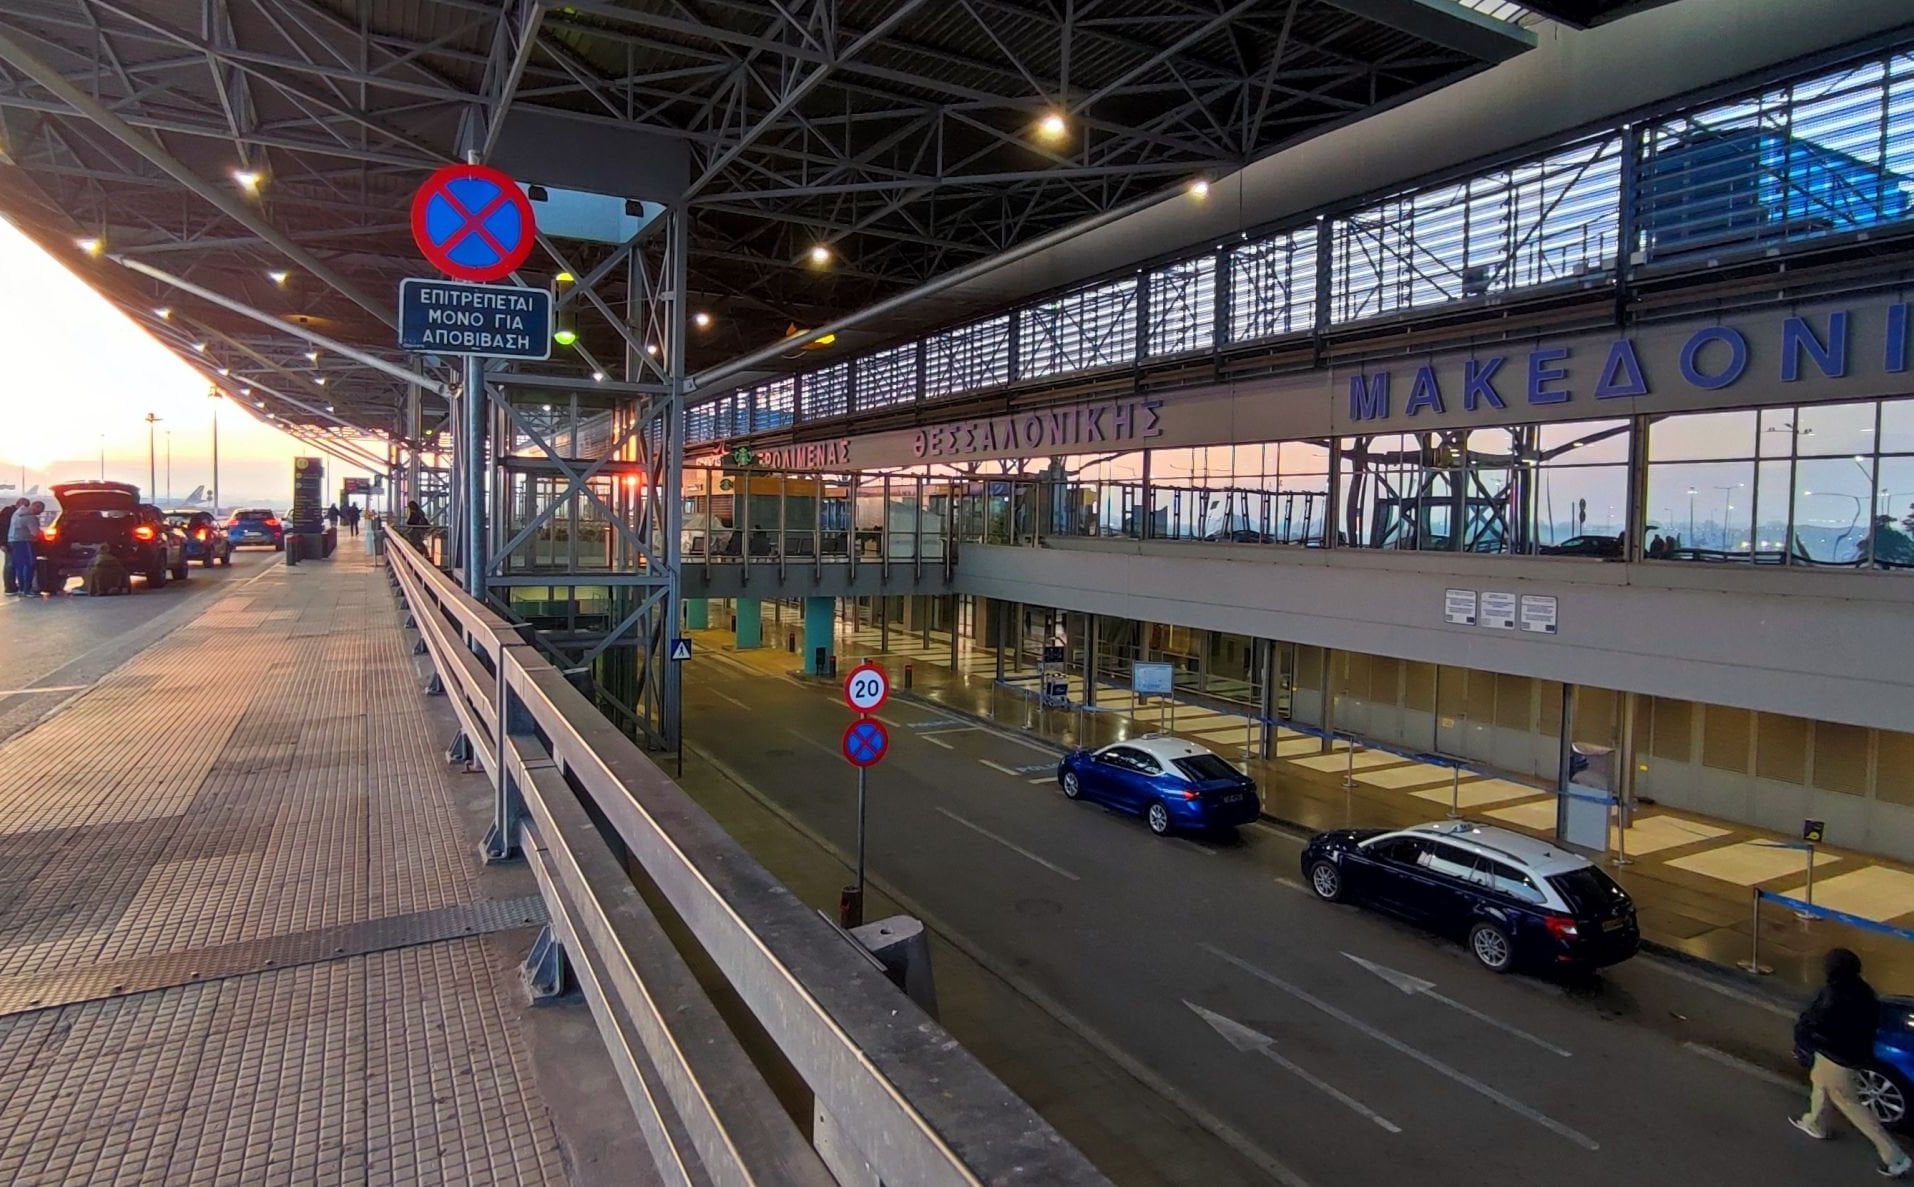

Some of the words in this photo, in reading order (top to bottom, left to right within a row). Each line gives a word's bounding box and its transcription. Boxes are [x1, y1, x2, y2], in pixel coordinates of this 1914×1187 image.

[420, 288, 533, 312] ΕΠΙΤΡΕΠΕΤΑΙ
[428, 308, 484, 328] ΜΟΝΟ
[495, 313, 524, 330] ΓΙΑ
[422, 329, 530, 350] ΑΠΟΒΙΒΑΣΗ
[913, 400, 1164, 458] ΘΕΣΣΑΛΟΝΙΚΗΣ
[1348, 302, 1908, 421] ΜΑΚΕΔΟΝΙ
[855, 679, 880, 699] 20
